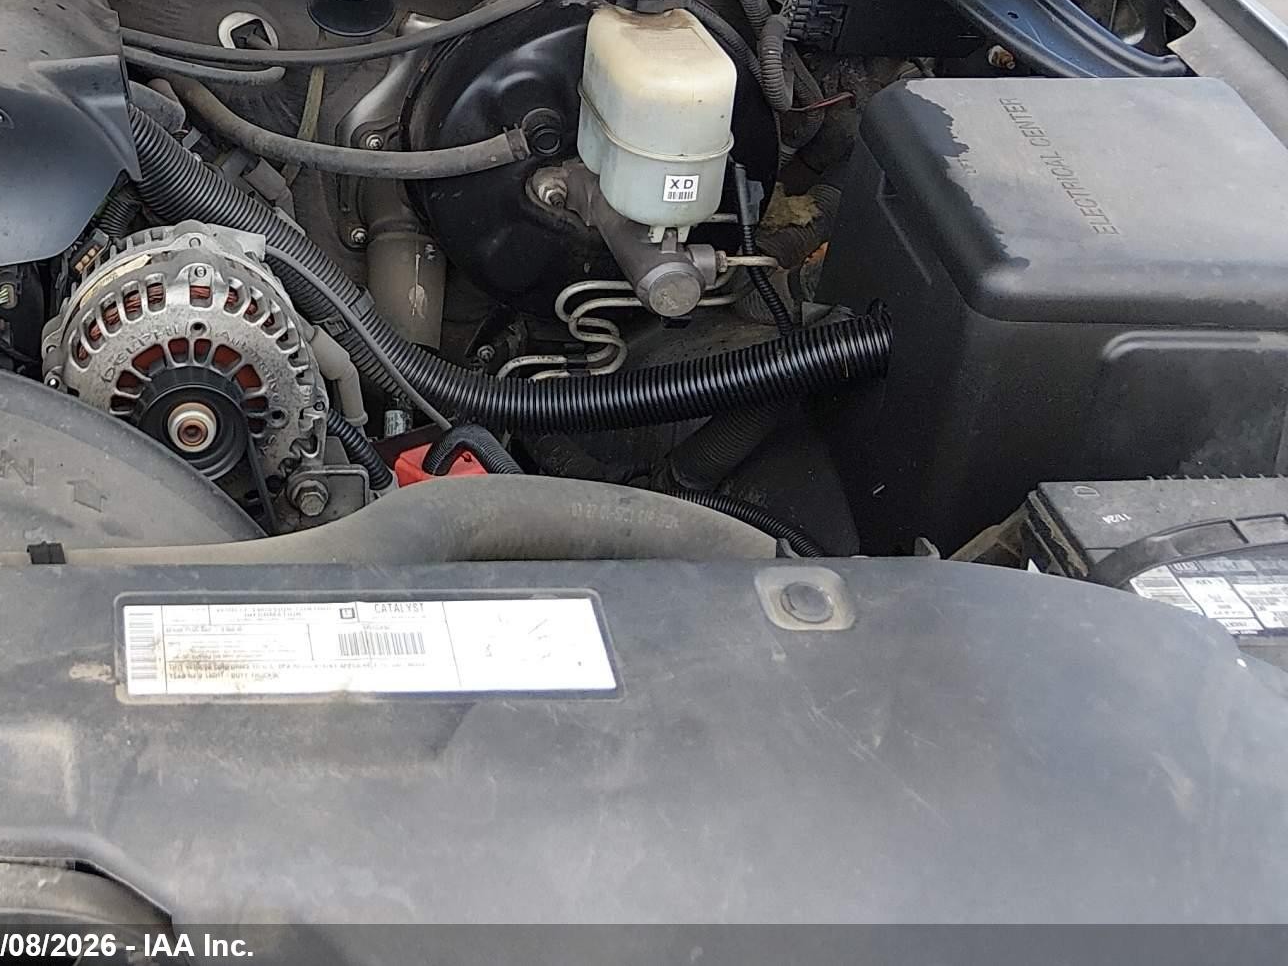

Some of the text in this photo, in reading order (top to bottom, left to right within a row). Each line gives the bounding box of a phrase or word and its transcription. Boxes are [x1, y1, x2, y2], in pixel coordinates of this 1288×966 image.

[999, 97, 1119, 234] ELECTRICAL CENTER
[374, 602, 425, 614] CATALYST
